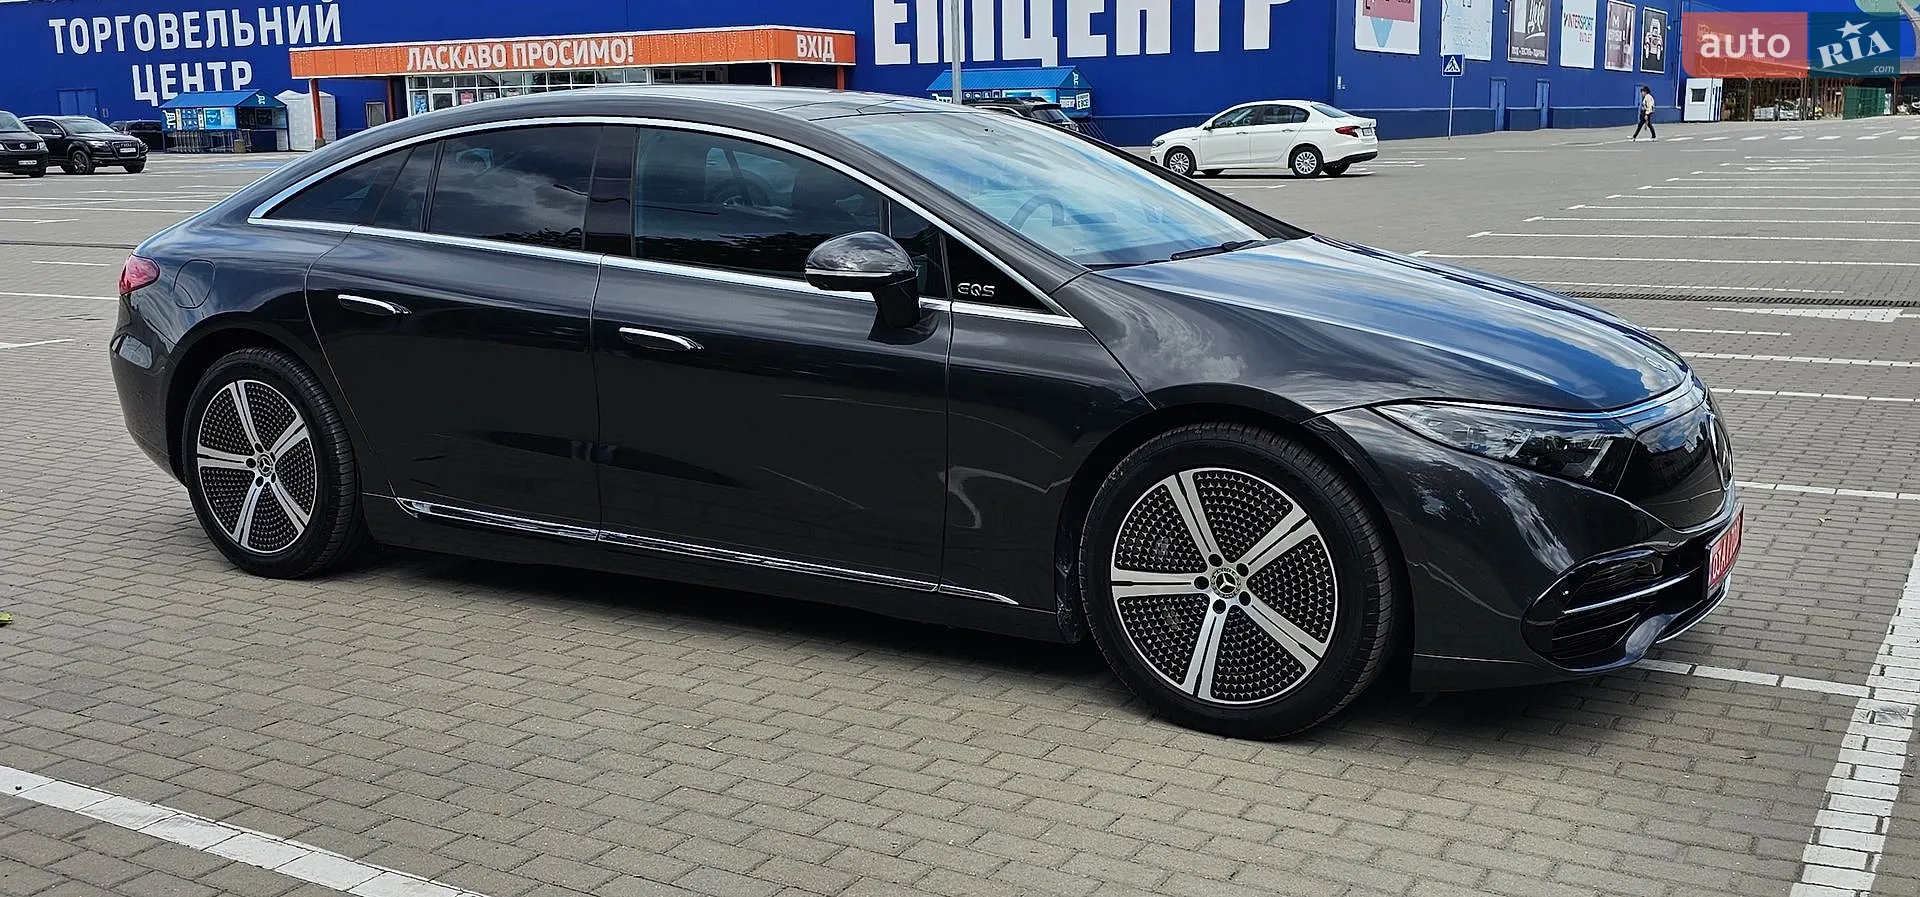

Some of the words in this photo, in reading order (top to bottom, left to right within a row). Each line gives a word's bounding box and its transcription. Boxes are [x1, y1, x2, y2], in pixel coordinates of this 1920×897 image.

[49, 0, 342, 54] ТОРГОВЕЛЬНИЙ
[407, 38, 506, 71] ЛАСКАВО
[512, 37, 634, 67] ПРОСИМО!
[796, 34, 836, 63] ВХІД
[132, 61, 253, 107] ЦЕНТР
[957, 282, 995, 297] EQS
